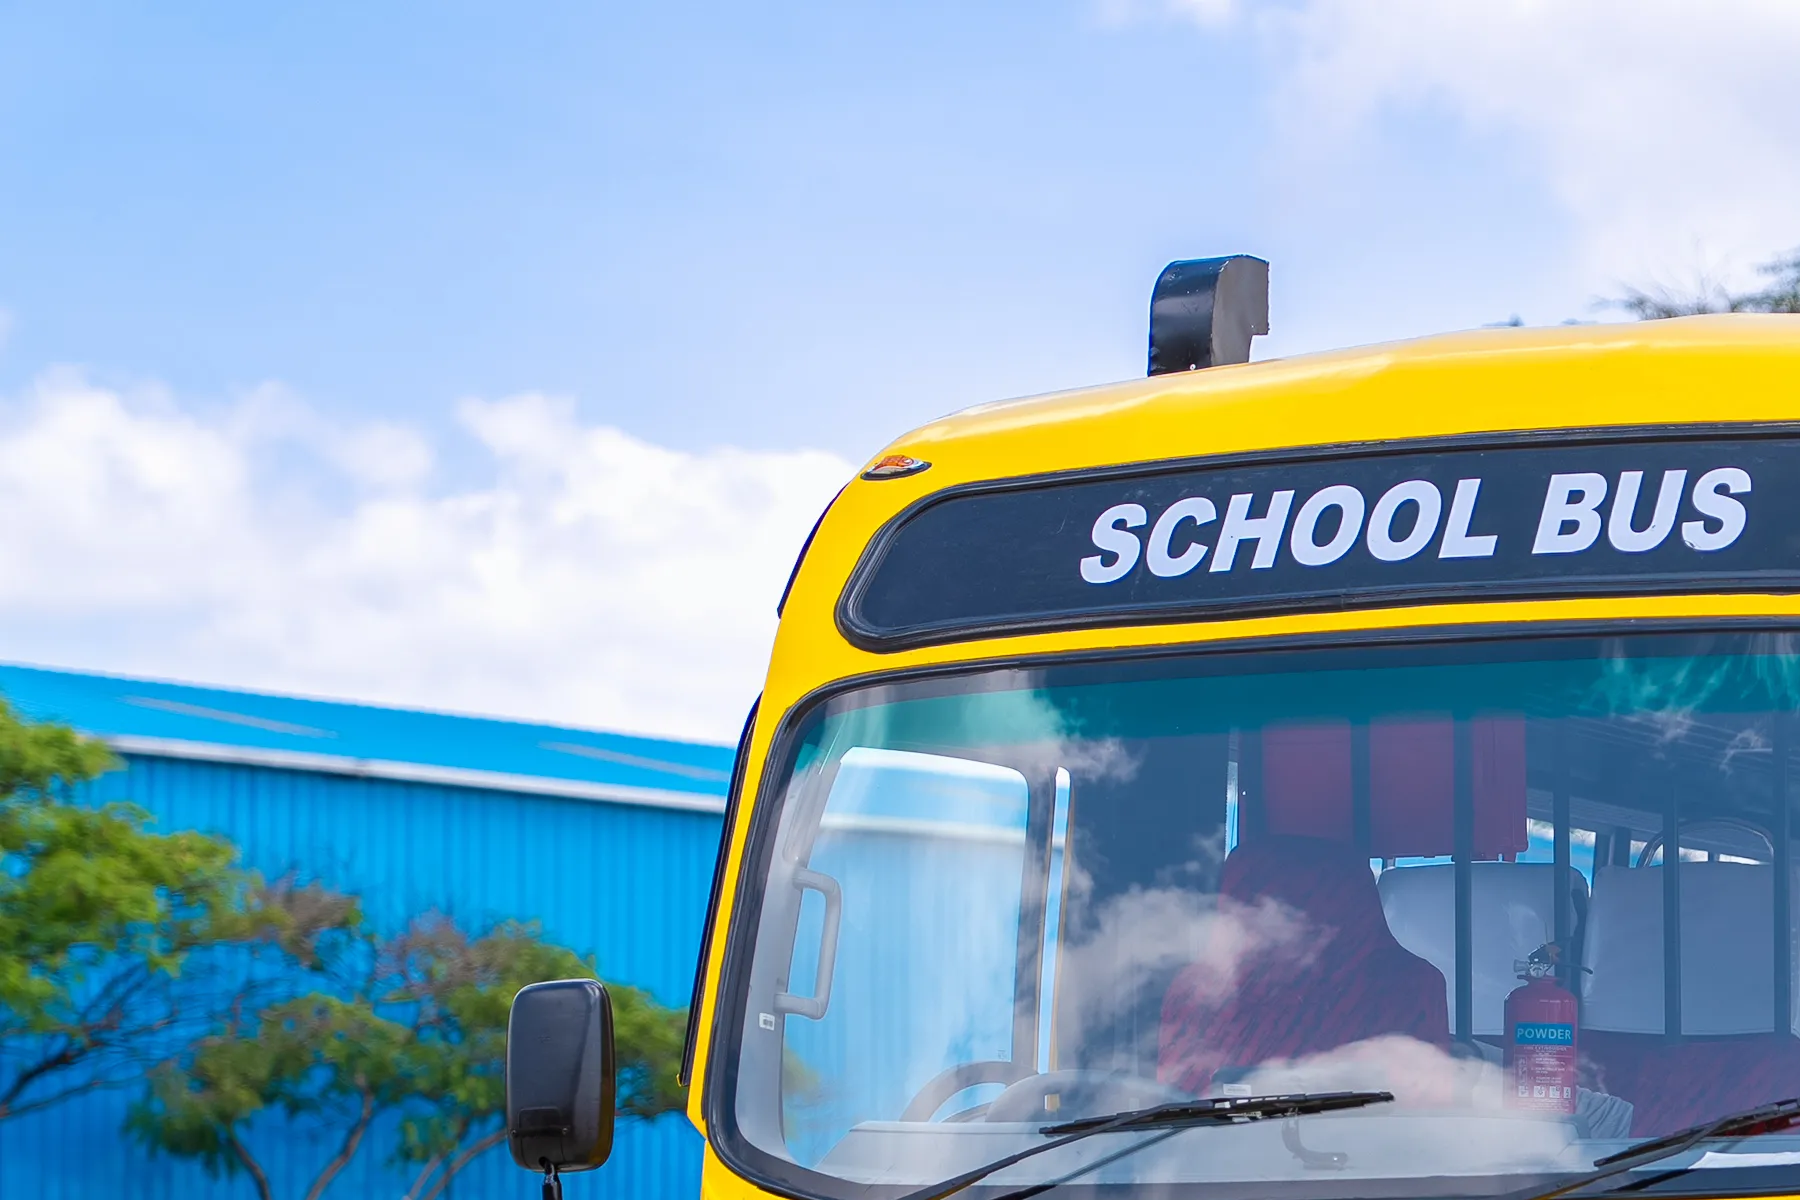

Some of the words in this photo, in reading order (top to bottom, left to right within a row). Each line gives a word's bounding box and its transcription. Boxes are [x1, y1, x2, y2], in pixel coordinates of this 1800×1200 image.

[1078, 478, 1500, 586] SCHOOL
[1530, 466, 1753, 555] BUS
[1517, 1028, 1571, 1040] POWDER
